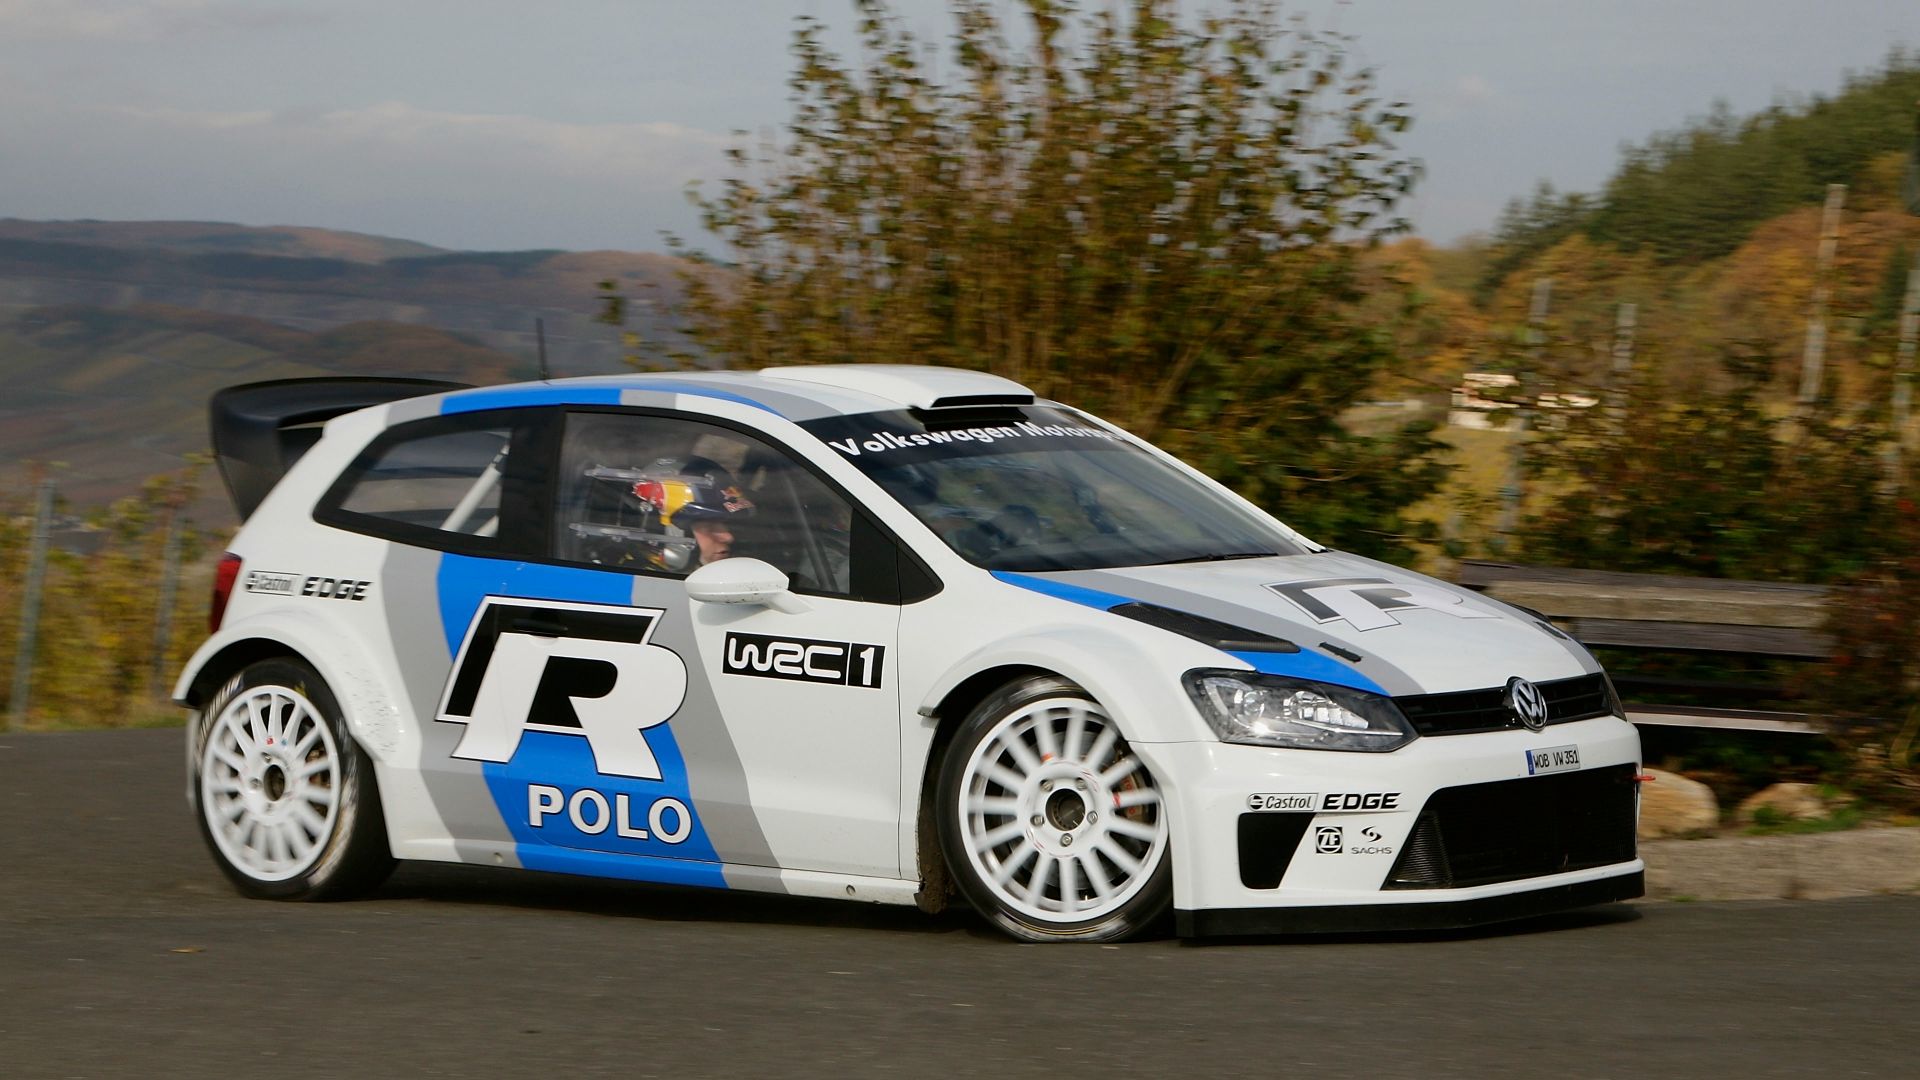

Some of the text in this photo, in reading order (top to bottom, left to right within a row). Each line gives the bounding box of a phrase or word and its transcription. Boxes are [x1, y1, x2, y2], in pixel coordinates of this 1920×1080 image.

[829, 425, 1022, 457] Volkswagen
[301, 576, 374, 601] EDGE
[727, 637, 875, 686] WRC 1
[450, 631, 688, 781] R
[1533, 749, 1579, 769] WOB VW 351
[1265, 792, 1402, 810] Castrol EDGE
[528, 784, 692, 845] POLO
[1317, 831, 1340, 848] ZF
[1350, 846, 1393, 855] SACHS
